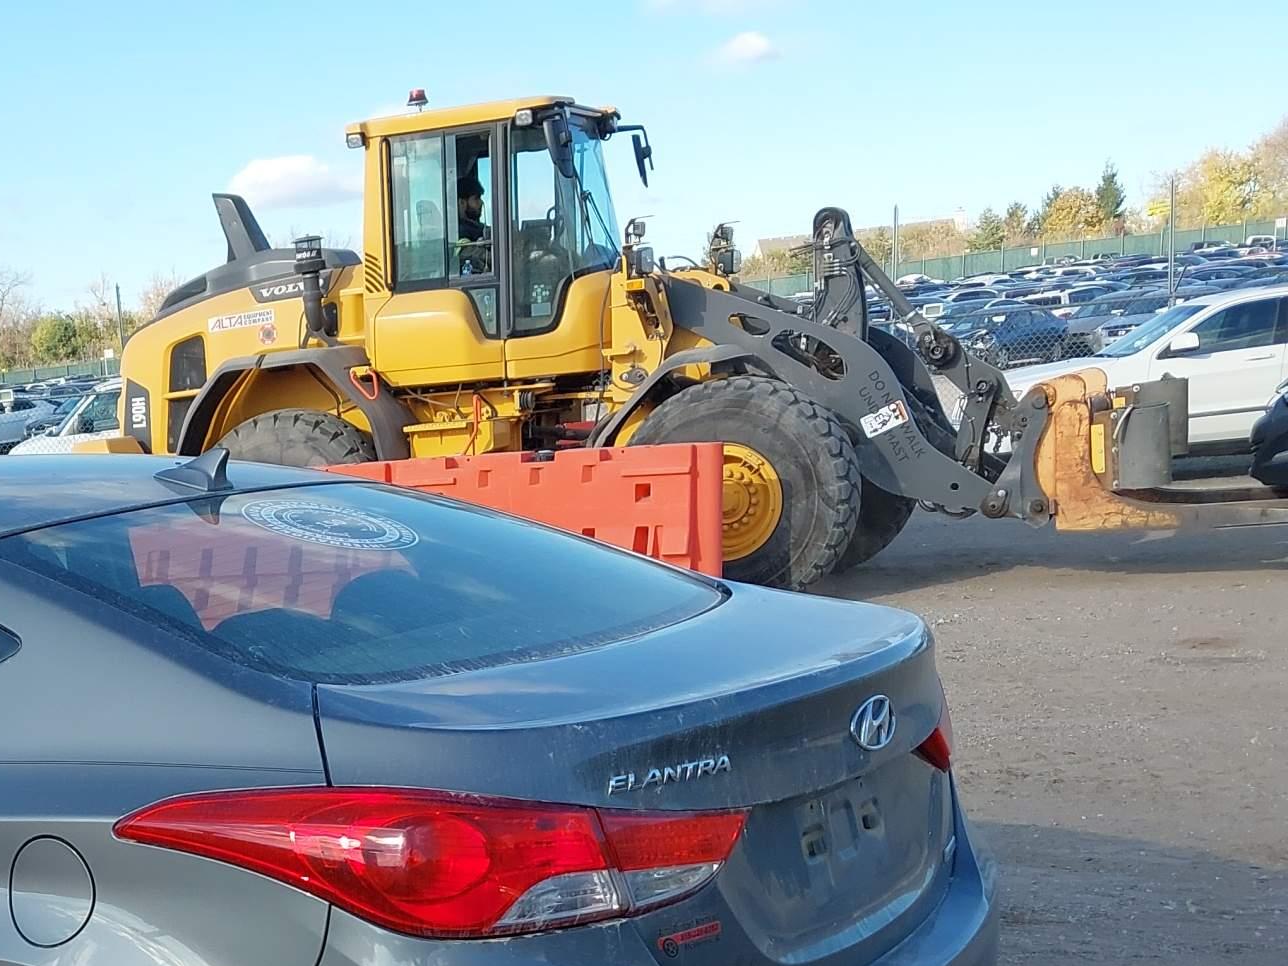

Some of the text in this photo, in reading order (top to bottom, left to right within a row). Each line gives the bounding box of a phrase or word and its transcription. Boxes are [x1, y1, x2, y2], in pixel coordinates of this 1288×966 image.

[260, 282, 304, 298] VOLV
[211, 315, 243, 330] ALTA
[244, 310, 272, 319] EQUIPMENT
[244, 316, 272, 325] COMPANY
[132, 397, 146, 428] L90H
[868, 371, 885, 391] DO
[900, 424, 926, 458] WALK
[884, 431, 909, 461] MAST
[608, 755, 732, 796] ELANTRA
